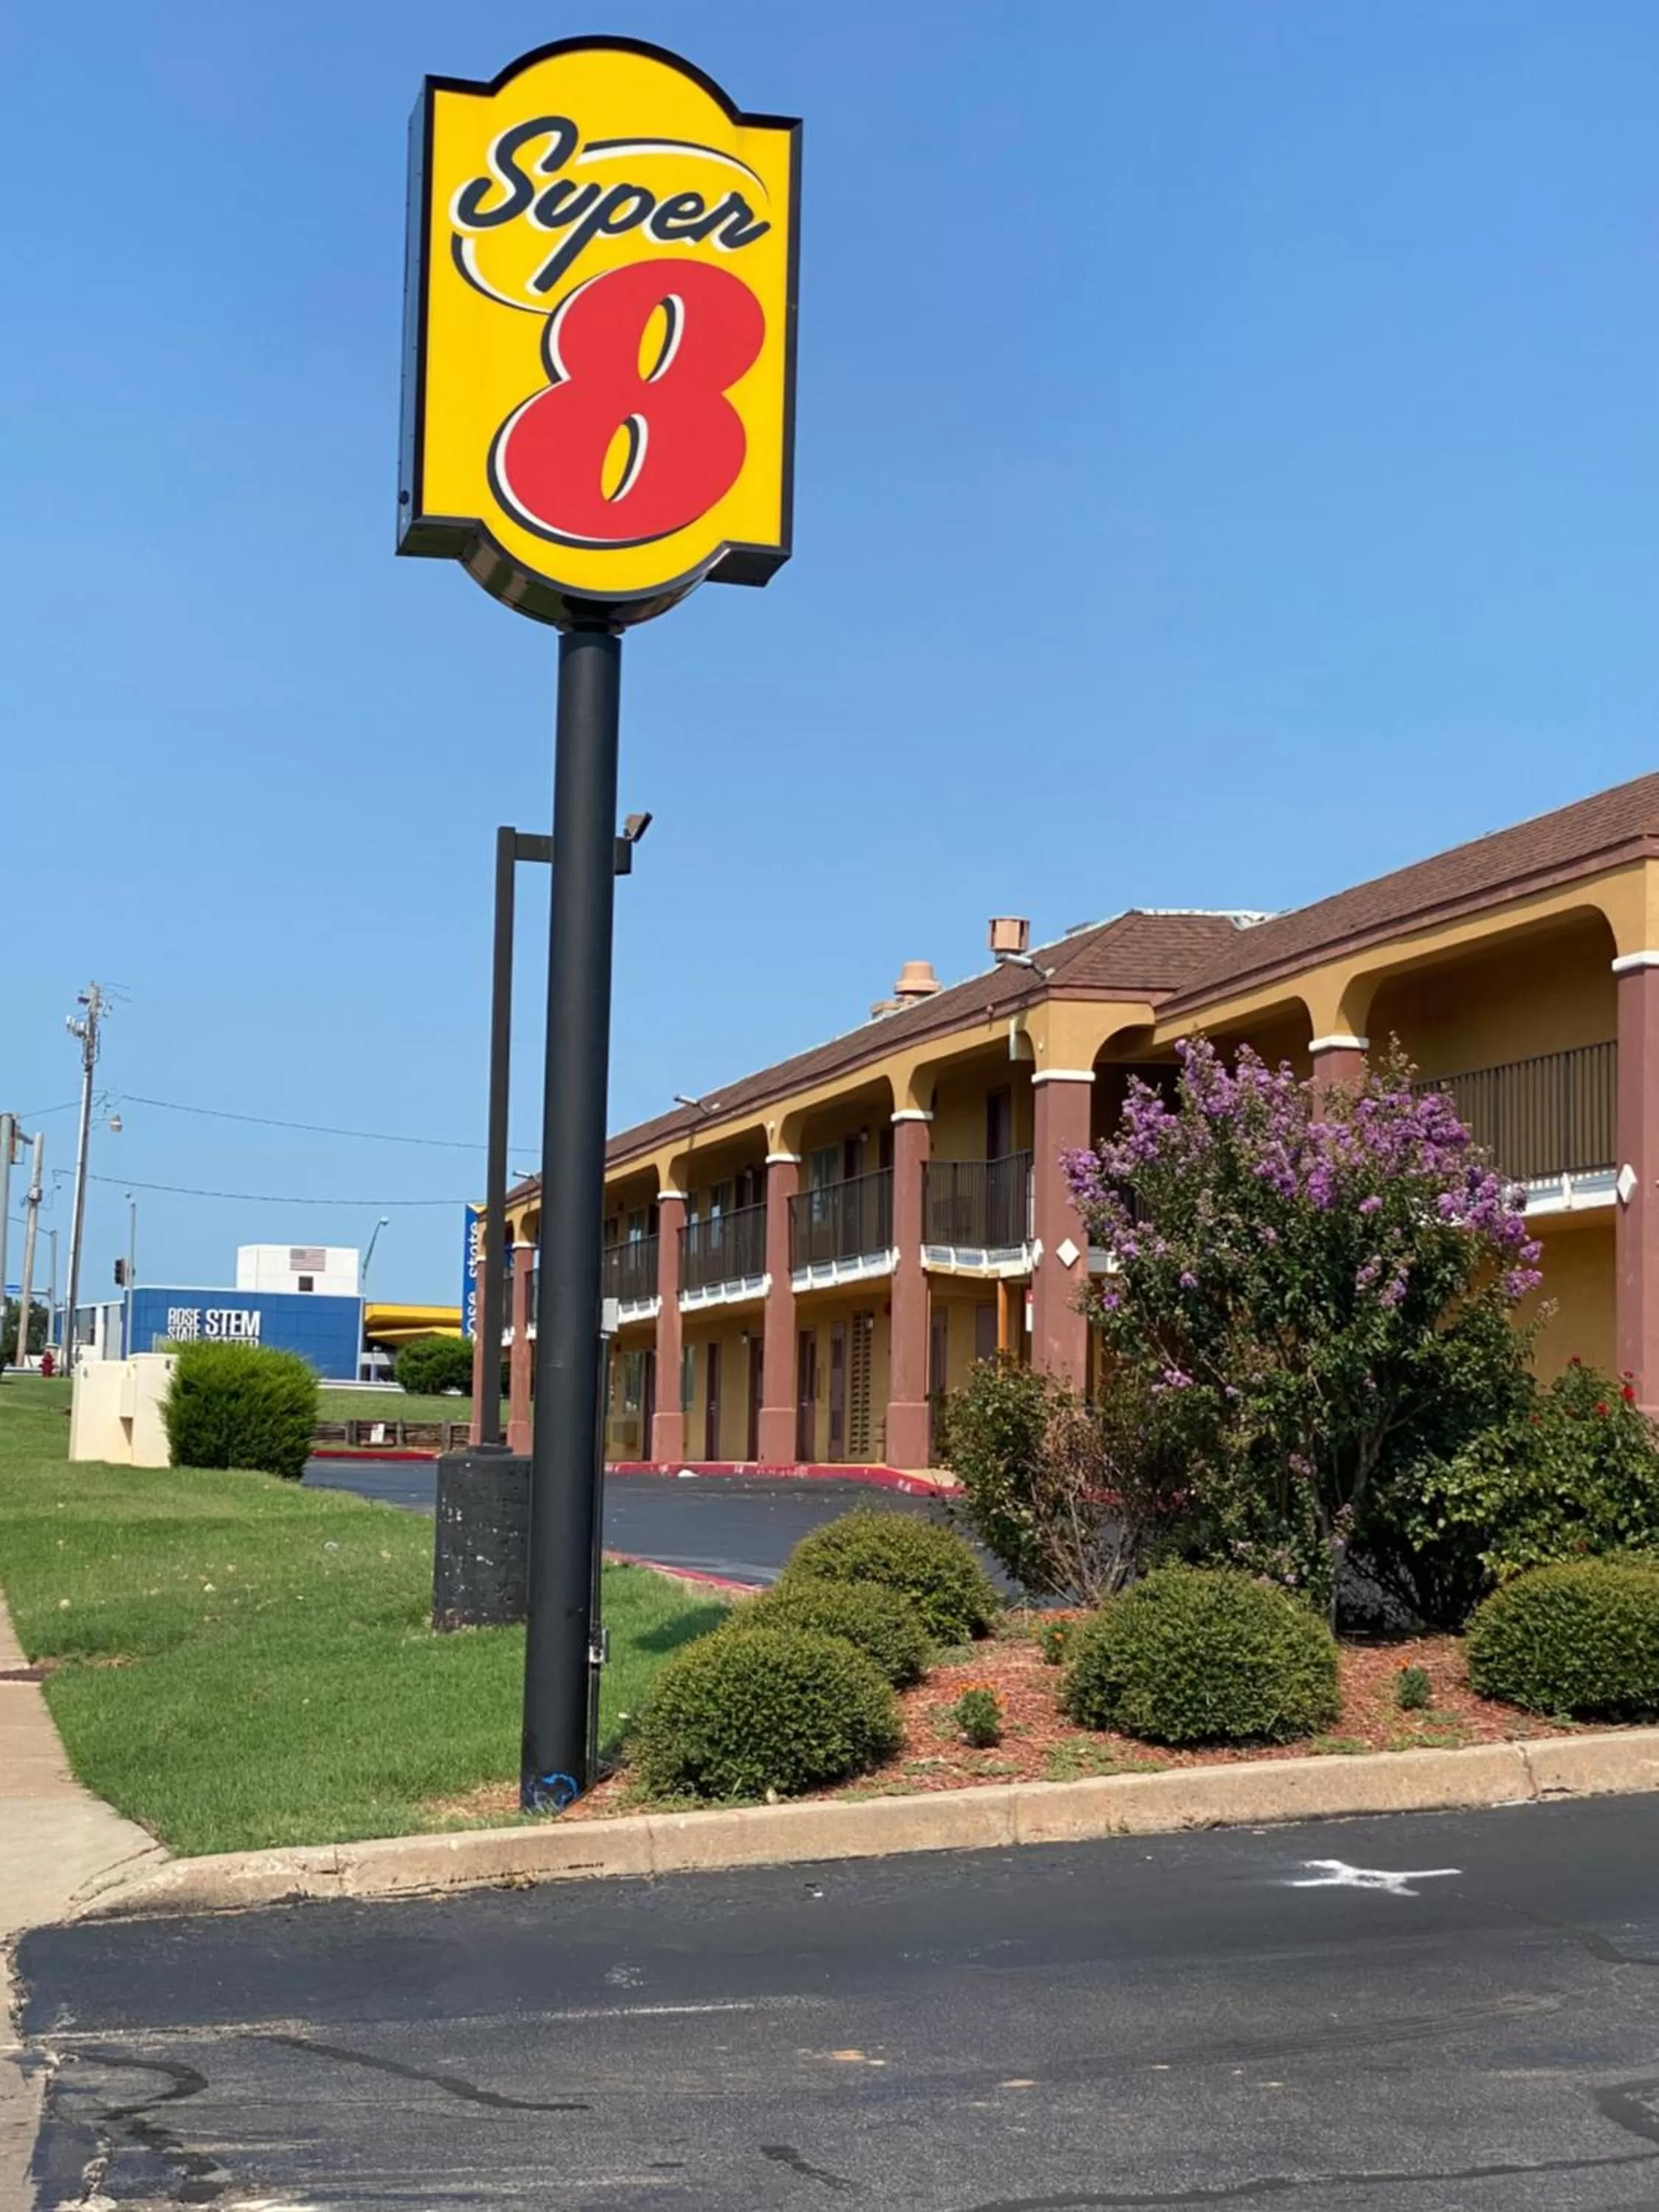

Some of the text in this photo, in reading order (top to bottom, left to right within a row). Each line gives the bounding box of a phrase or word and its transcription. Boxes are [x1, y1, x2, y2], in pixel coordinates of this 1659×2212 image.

[451, 115, 771, 295] Super
[487, 258, 766, 551] 8
[168, 1307, 201, 1326] ROSE
[205, 1309, 260, 1337] STEM
